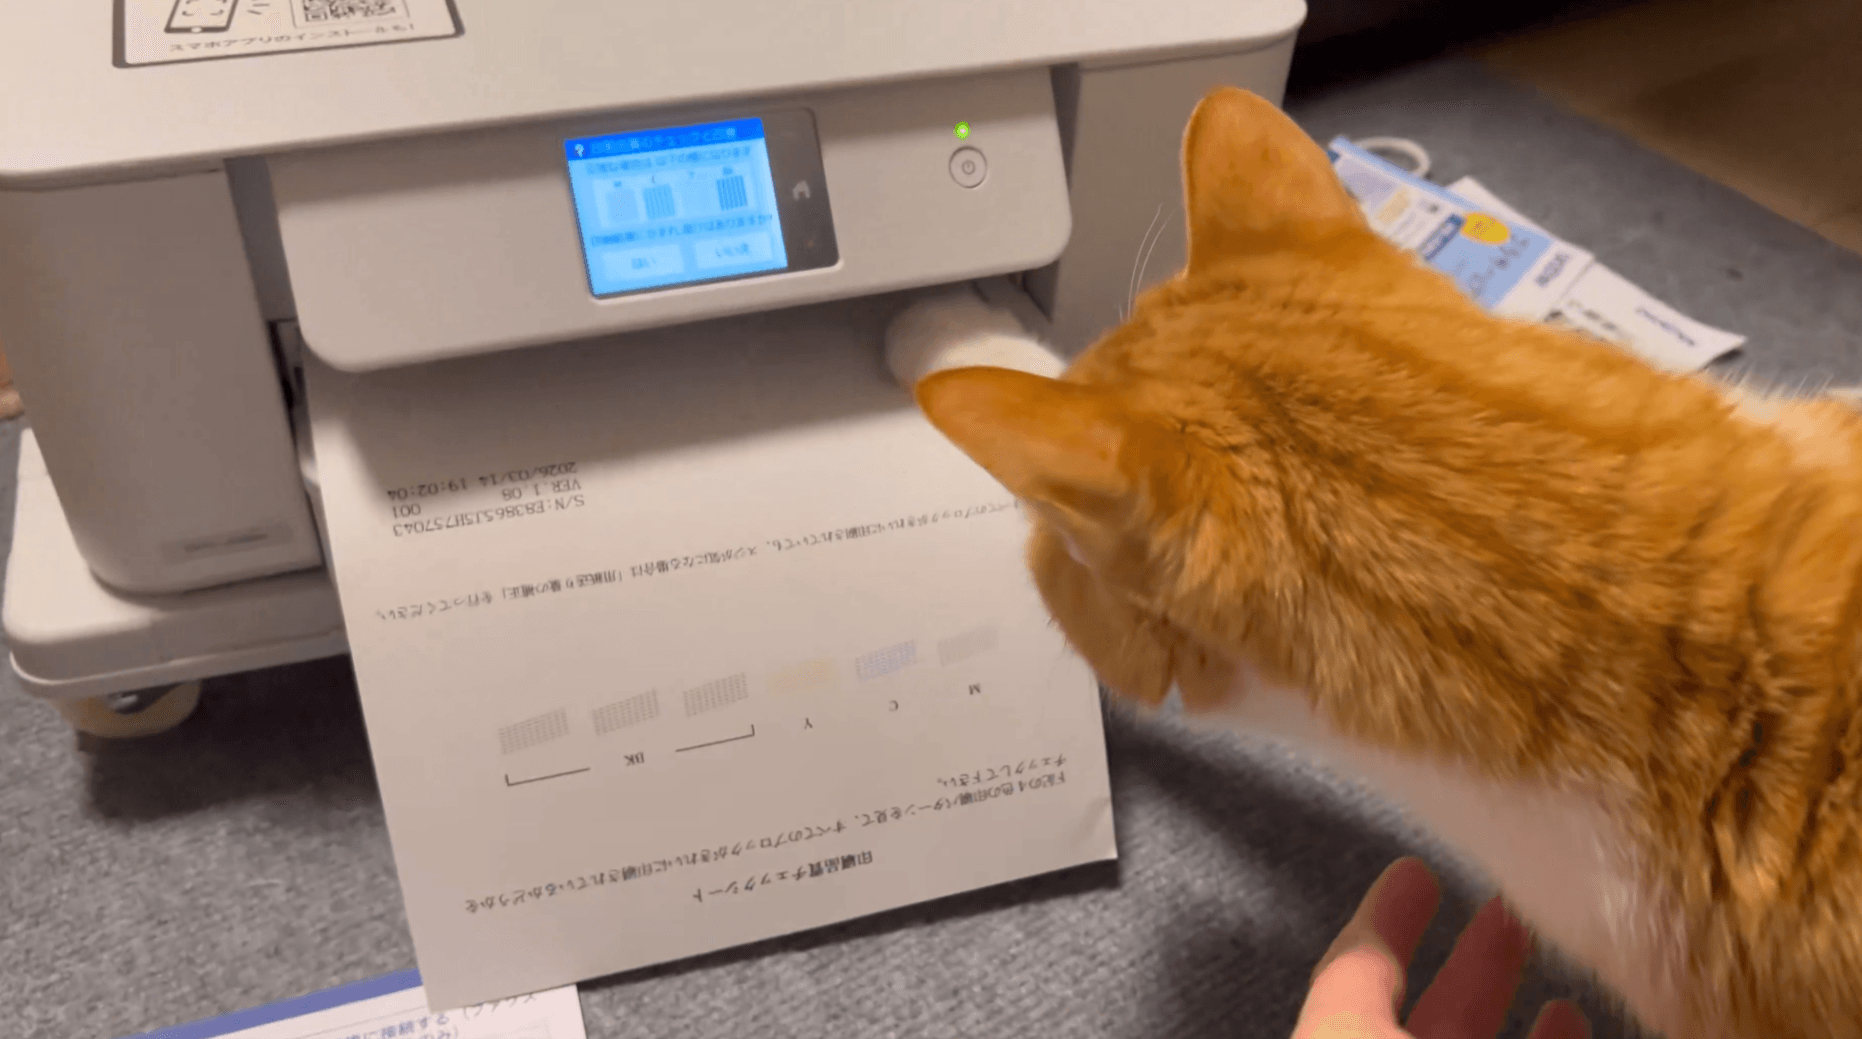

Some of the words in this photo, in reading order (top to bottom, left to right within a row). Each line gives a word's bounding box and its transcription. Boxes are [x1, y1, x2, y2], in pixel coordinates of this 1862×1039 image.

[479, 462, 577, 487] 2026/03/14
[386, 478, 466, 501] 19:02:04
[391, 503, 422, 519] 001
[968, 683, 982, 696] M
[889, 699, 900, 712] C
[803, 717, 814, 730] Y
[623, 751, 645, 766] BK
[693, 851, 874, 902] 印刷品質チェックシート
